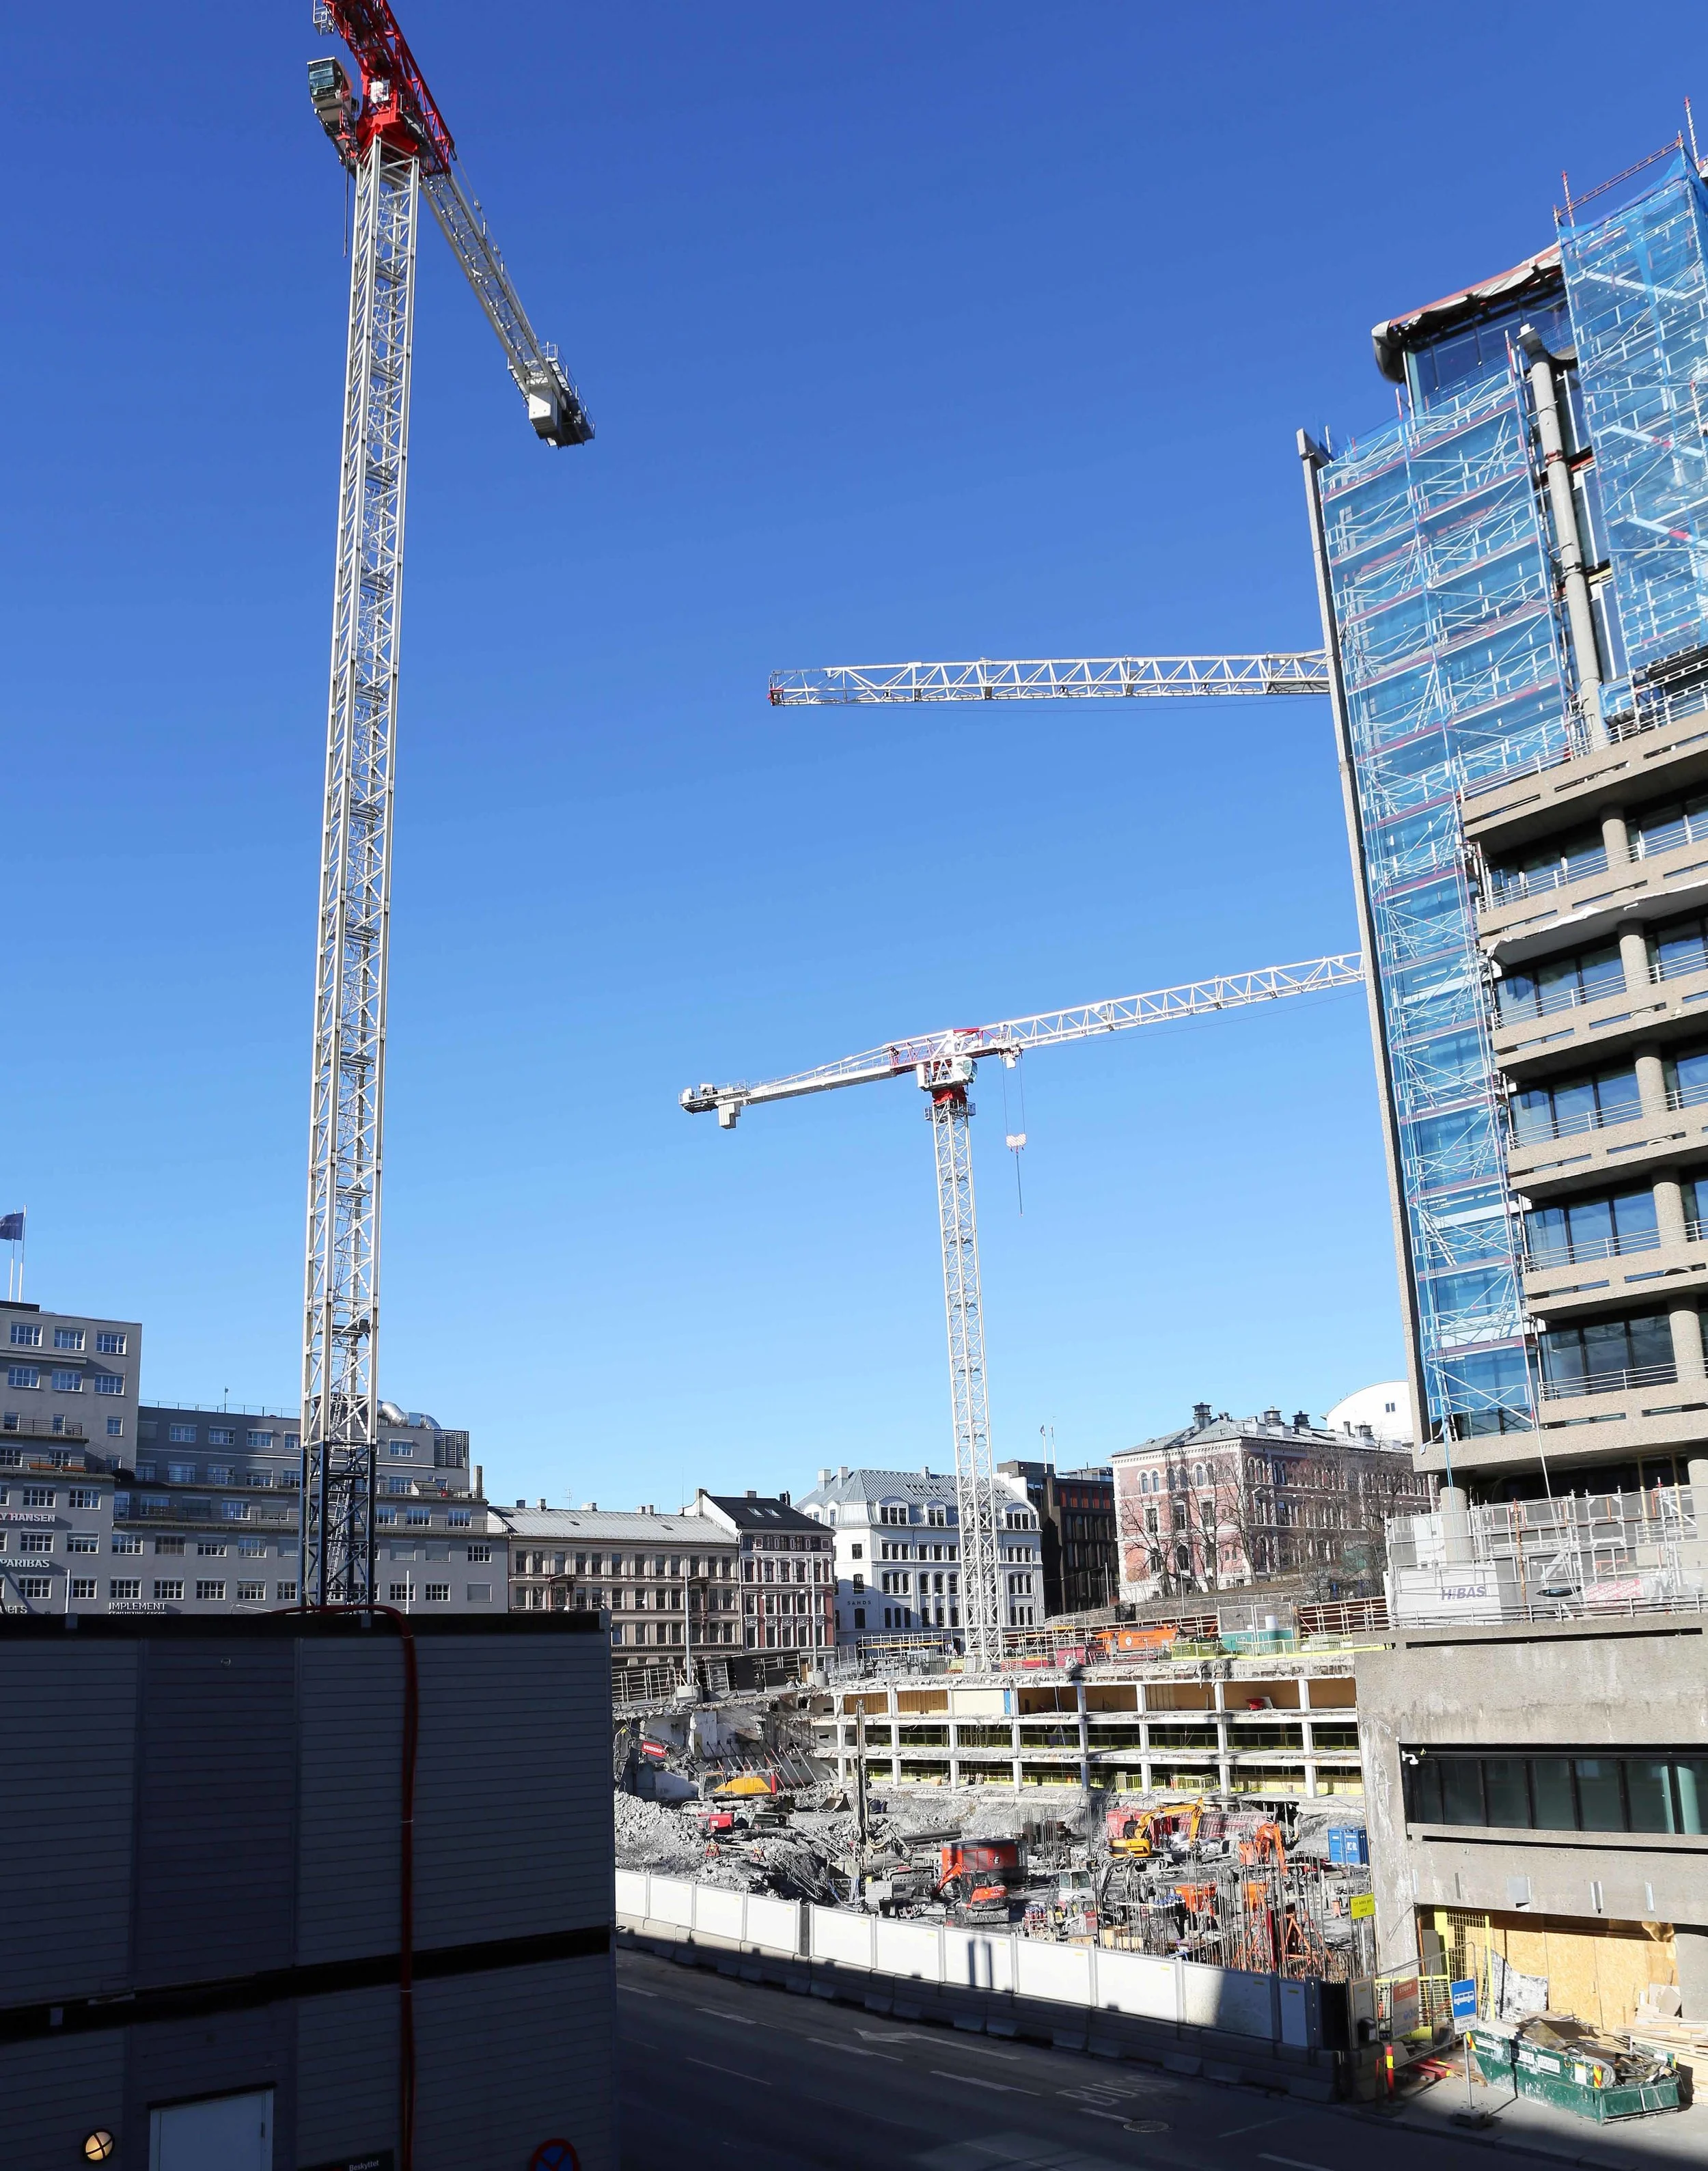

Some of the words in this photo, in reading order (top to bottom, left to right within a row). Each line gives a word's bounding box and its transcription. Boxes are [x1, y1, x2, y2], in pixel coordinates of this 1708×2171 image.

[10, 1513, 55, 1522] HANSEN
[109, 1602, 167, 1610] IMPLEMENT
[1399, 1983, 1413, 1994] STOPP
[1054, 2075, 1179, 2107] BUSS
[349, 2159, 380, 2171] Beskyttet
